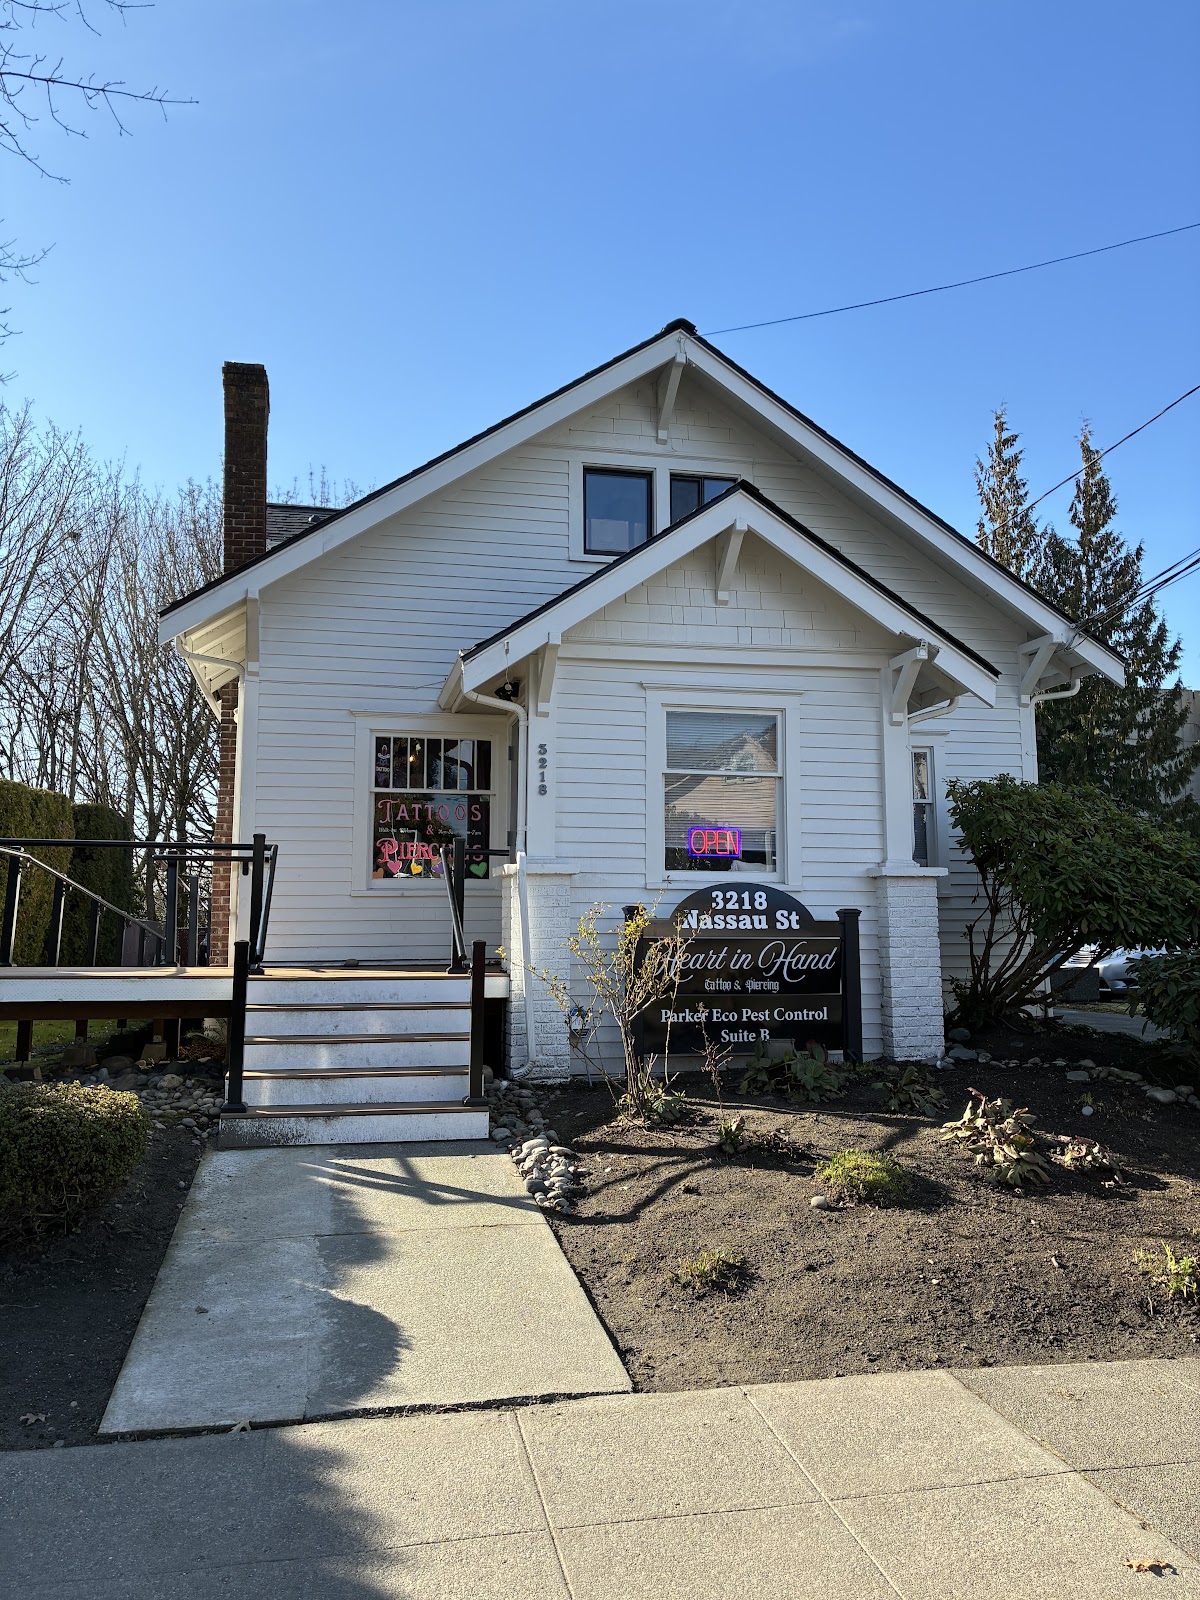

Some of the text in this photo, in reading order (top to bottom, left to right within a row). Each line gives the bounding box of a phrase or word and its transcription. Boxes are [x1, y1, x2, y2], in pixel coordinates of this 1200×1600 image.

[538, 743, 548, 796] 3218
[426, 824, 434, 835] &
[690, 829, 739, 855] OPEN
[711, 890, 768, 910] 3218
[682, 909, 800, 930] Nassau St
[645, 940, 838, 982] Heart in Hand
[704, 976, 780, 993] Tattoo & Piercing
[660, 1006, 828, 1023] Parker Eco Pest Control
[720, 1029, 757, 1043] Suite
